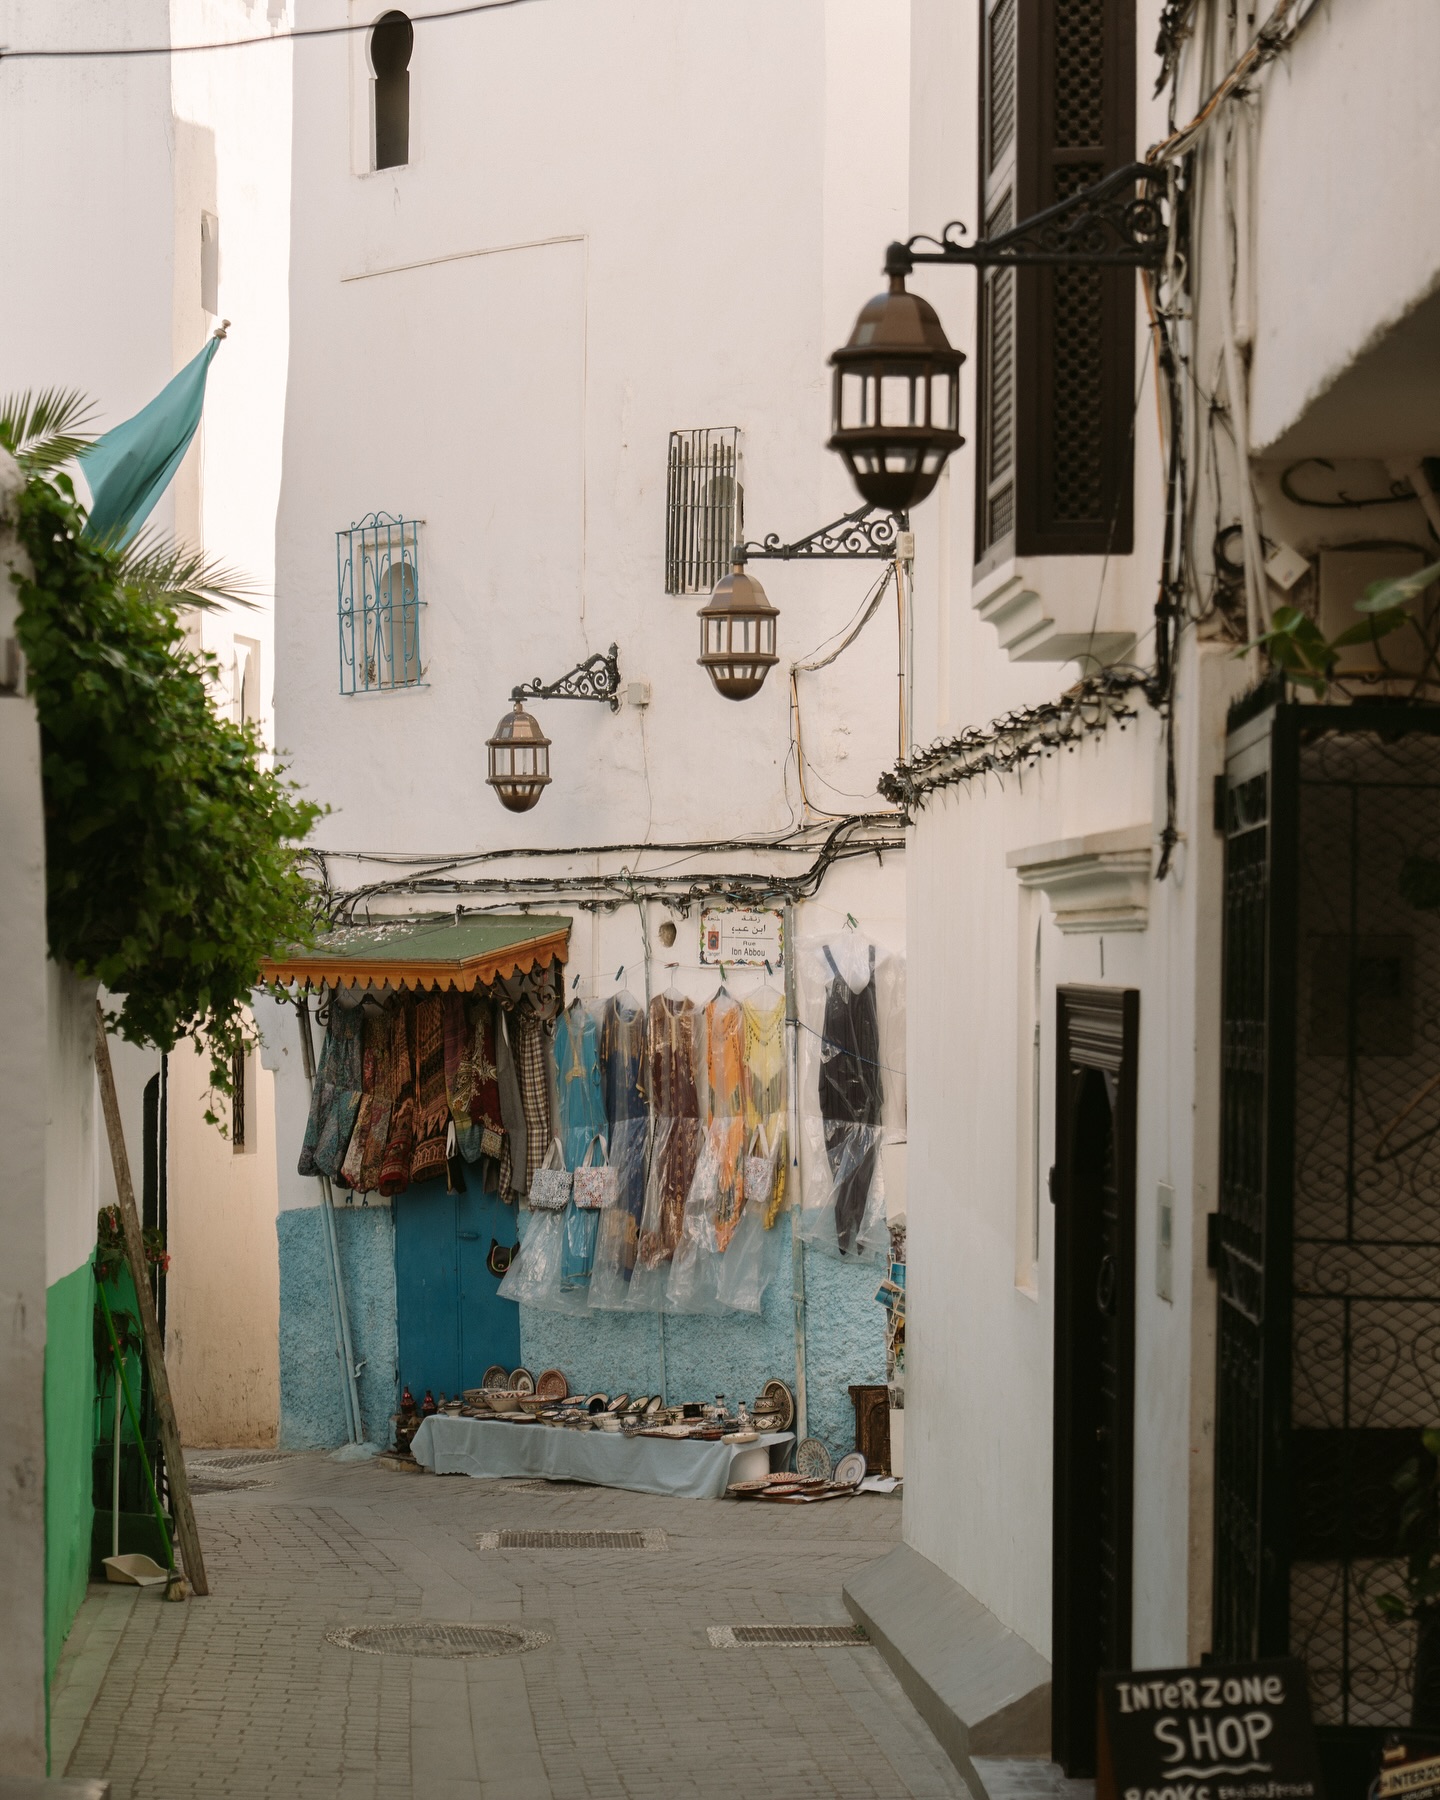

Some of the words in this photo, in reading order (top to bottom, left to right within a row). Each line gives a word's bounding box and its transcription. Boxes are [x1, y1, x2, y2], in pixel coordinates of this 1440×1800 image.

[752, 924, 766, 935] ابن
[731, 947, 742, 956] Ibn
[744, 948, 766, 957] Abbou
[1154, 1711, 1273, 1763] SHOP
